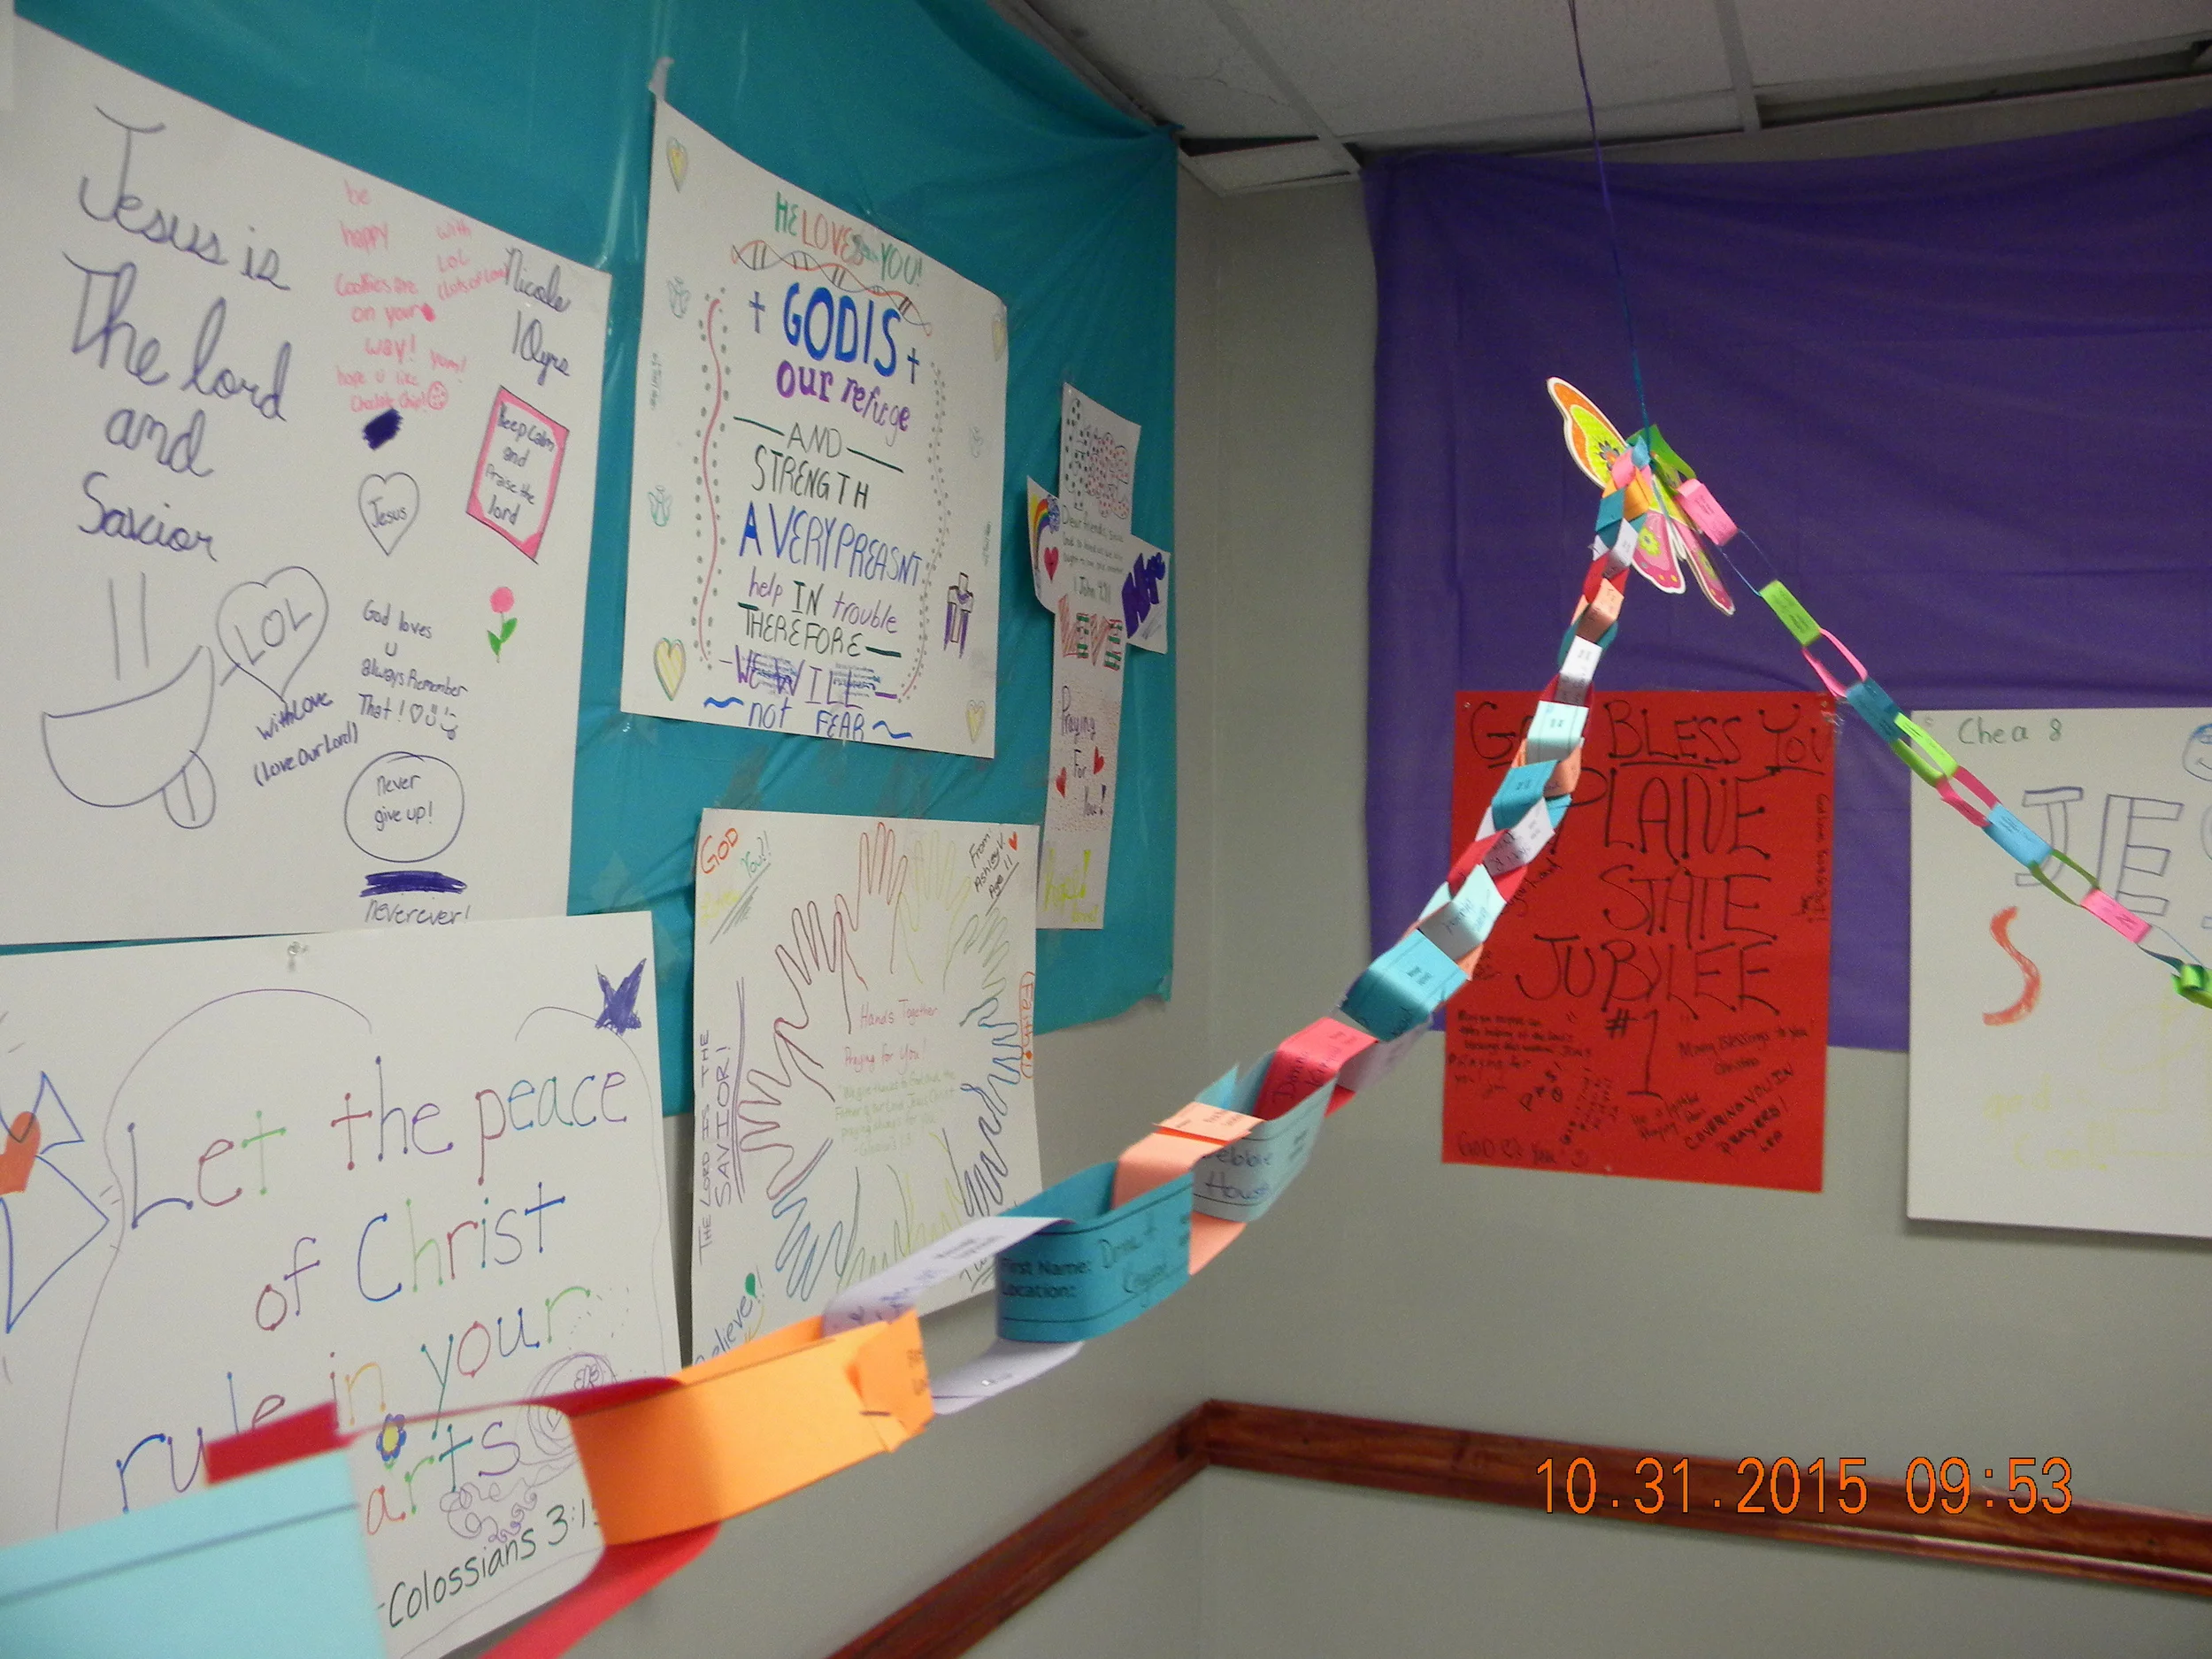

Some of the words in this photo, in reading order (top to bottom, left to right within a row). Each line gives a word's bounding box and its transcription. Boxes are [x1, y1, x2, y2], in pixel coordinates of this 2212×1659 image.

[79, 105, 228, 266] Jesus
[242, 227, 290, 291] is
[775, 190, 798, 236] HE
[879, 242, 924, 288] YOU!
[62, 251, 169, 385] The
[180, 296, 294, 421] lord
[787, 422, 842, 459] AND
[841, 376, 911, 448] refuge
[104, 409, 213, 477] and
[503, 446, 530, 468] and
[751, 444, 870, 511] STRENGTH
[369, 496, 408, 529] Jesus
[739, 499, 763, 557] A
[363, 599, 391, 626] God
[399, 611, 433, 640] loves
[749, 565, 783, 608] help
[791, 580, 825, 617] IN
[833, 588, 899, 634] trouble
[234, 598, 312, 665] LOL
[737, 601, 864, 657] THEREFORE
[748, 696, 793, 729] not
[815, 709, 865, 742] FEAR
[1602, 699, 1741, 764] BLESS
[374, 805, 402, 832] give
[406, 801, 434, 826] up!
[700, 827, 739, 874] GOD
[973, 849, 1000, 893] Ashley
[1599, 864, 1778, 950] STATE
[860, 1001, 895, 1029] Hands
[898, 998, 939, 1025] Together
[700, 1029, 710, 1088] THE
[127, 1110, 288, 1231] Let
[330, 1055, 455, 1171] the
[474, 1069, 629, 1187] peace
[700, 1150, 711, 1207] LORD
[255, 1237, 321, 1333] of
[357, 1181, 567, 1302] Christ
[697, 1213, 712, 1267] THE
[420, 1284, 592, 1441] your
[546, 1498, 600, 1547] 3:1
